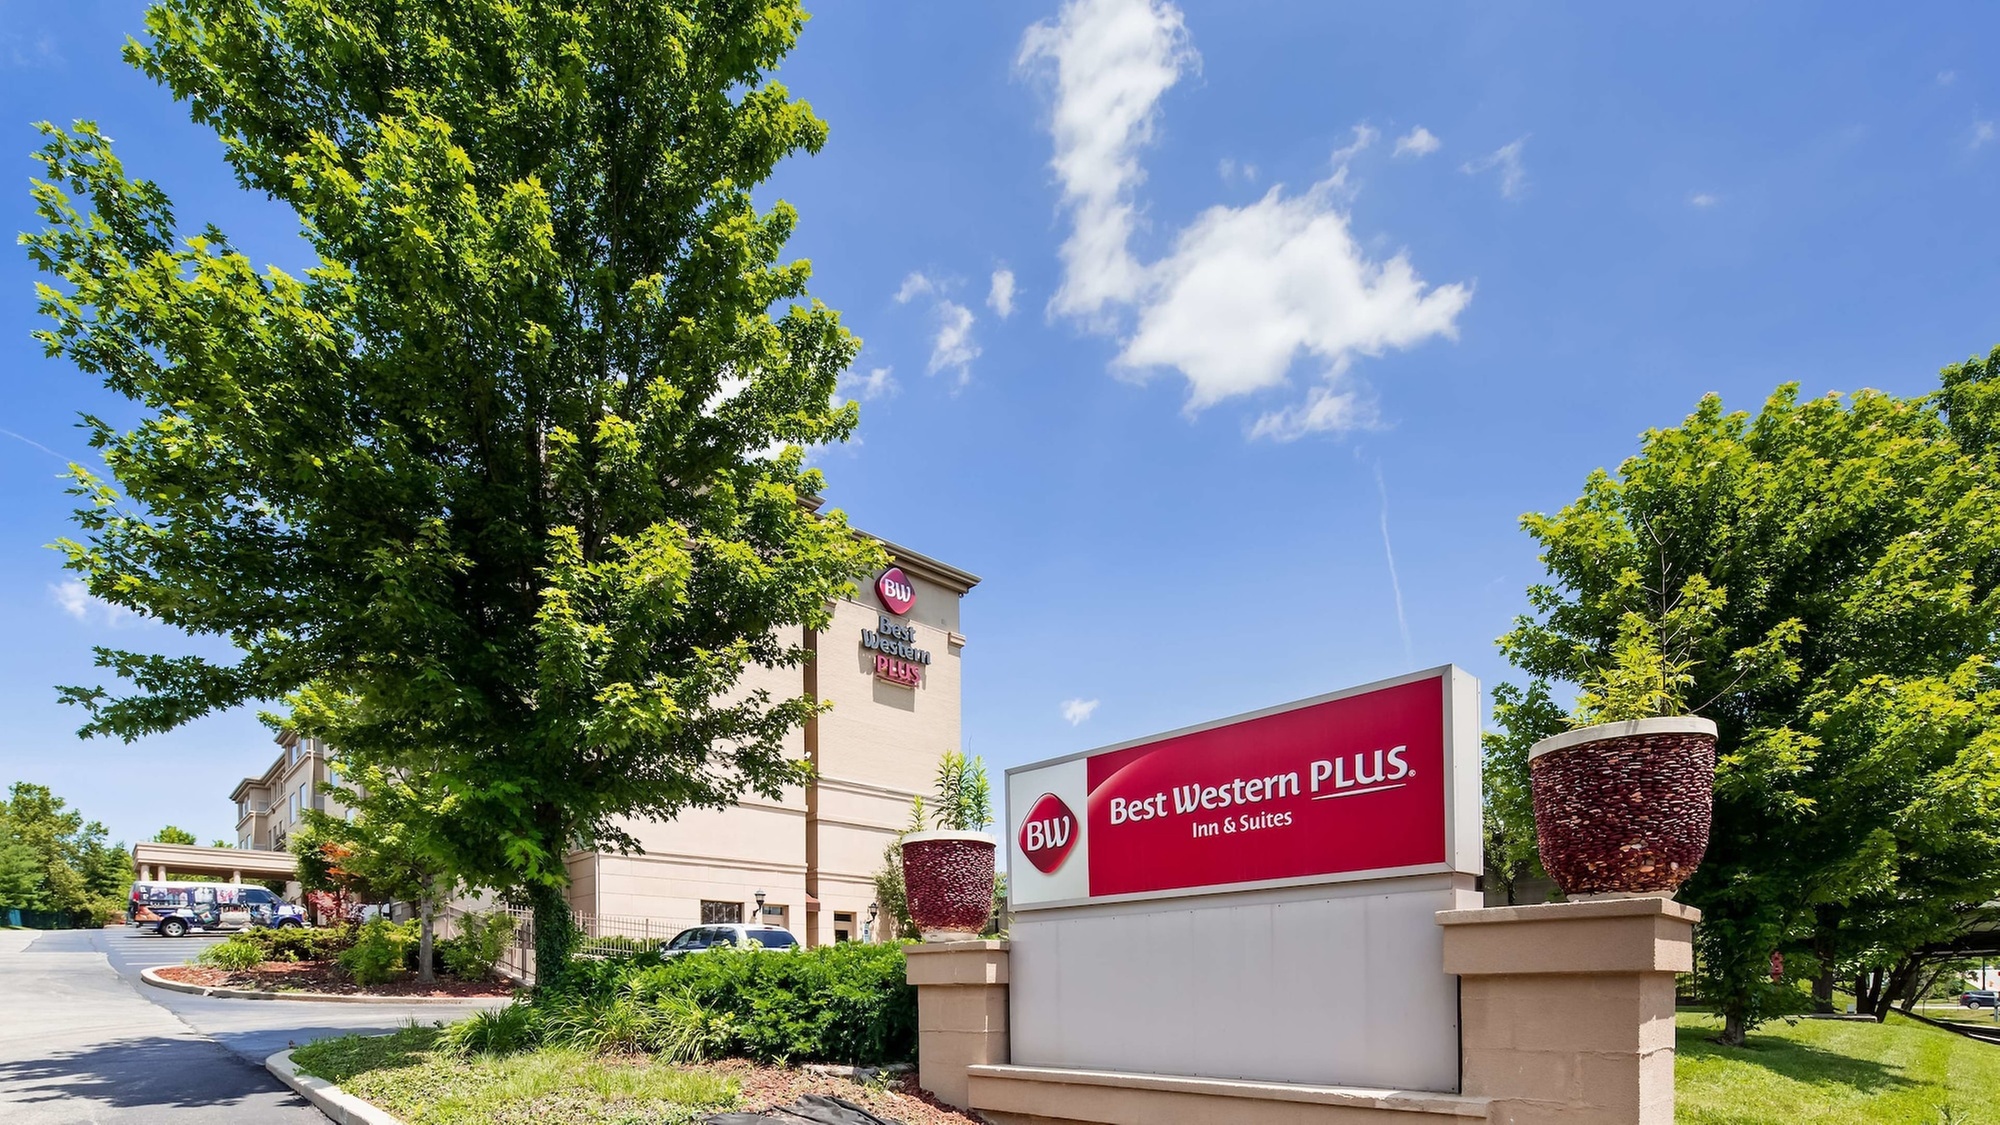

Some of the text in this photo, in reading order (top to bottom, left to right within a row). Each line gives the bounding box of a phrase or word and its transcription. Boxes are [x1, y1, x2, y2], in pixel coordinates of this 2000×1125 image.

[884, 579, 911, 602] BW
[879, 615, 916, 643] Best
[861, 628, 931, 665] Western
[875, 655, 920, 683] PLUS
[1110, 792, 1168, 825] Best
[1172, 771, 1300, 815] Western
[1026, 815, 1070, 852] BW
[1192, 811, 1293, 838] Inn & Suites
